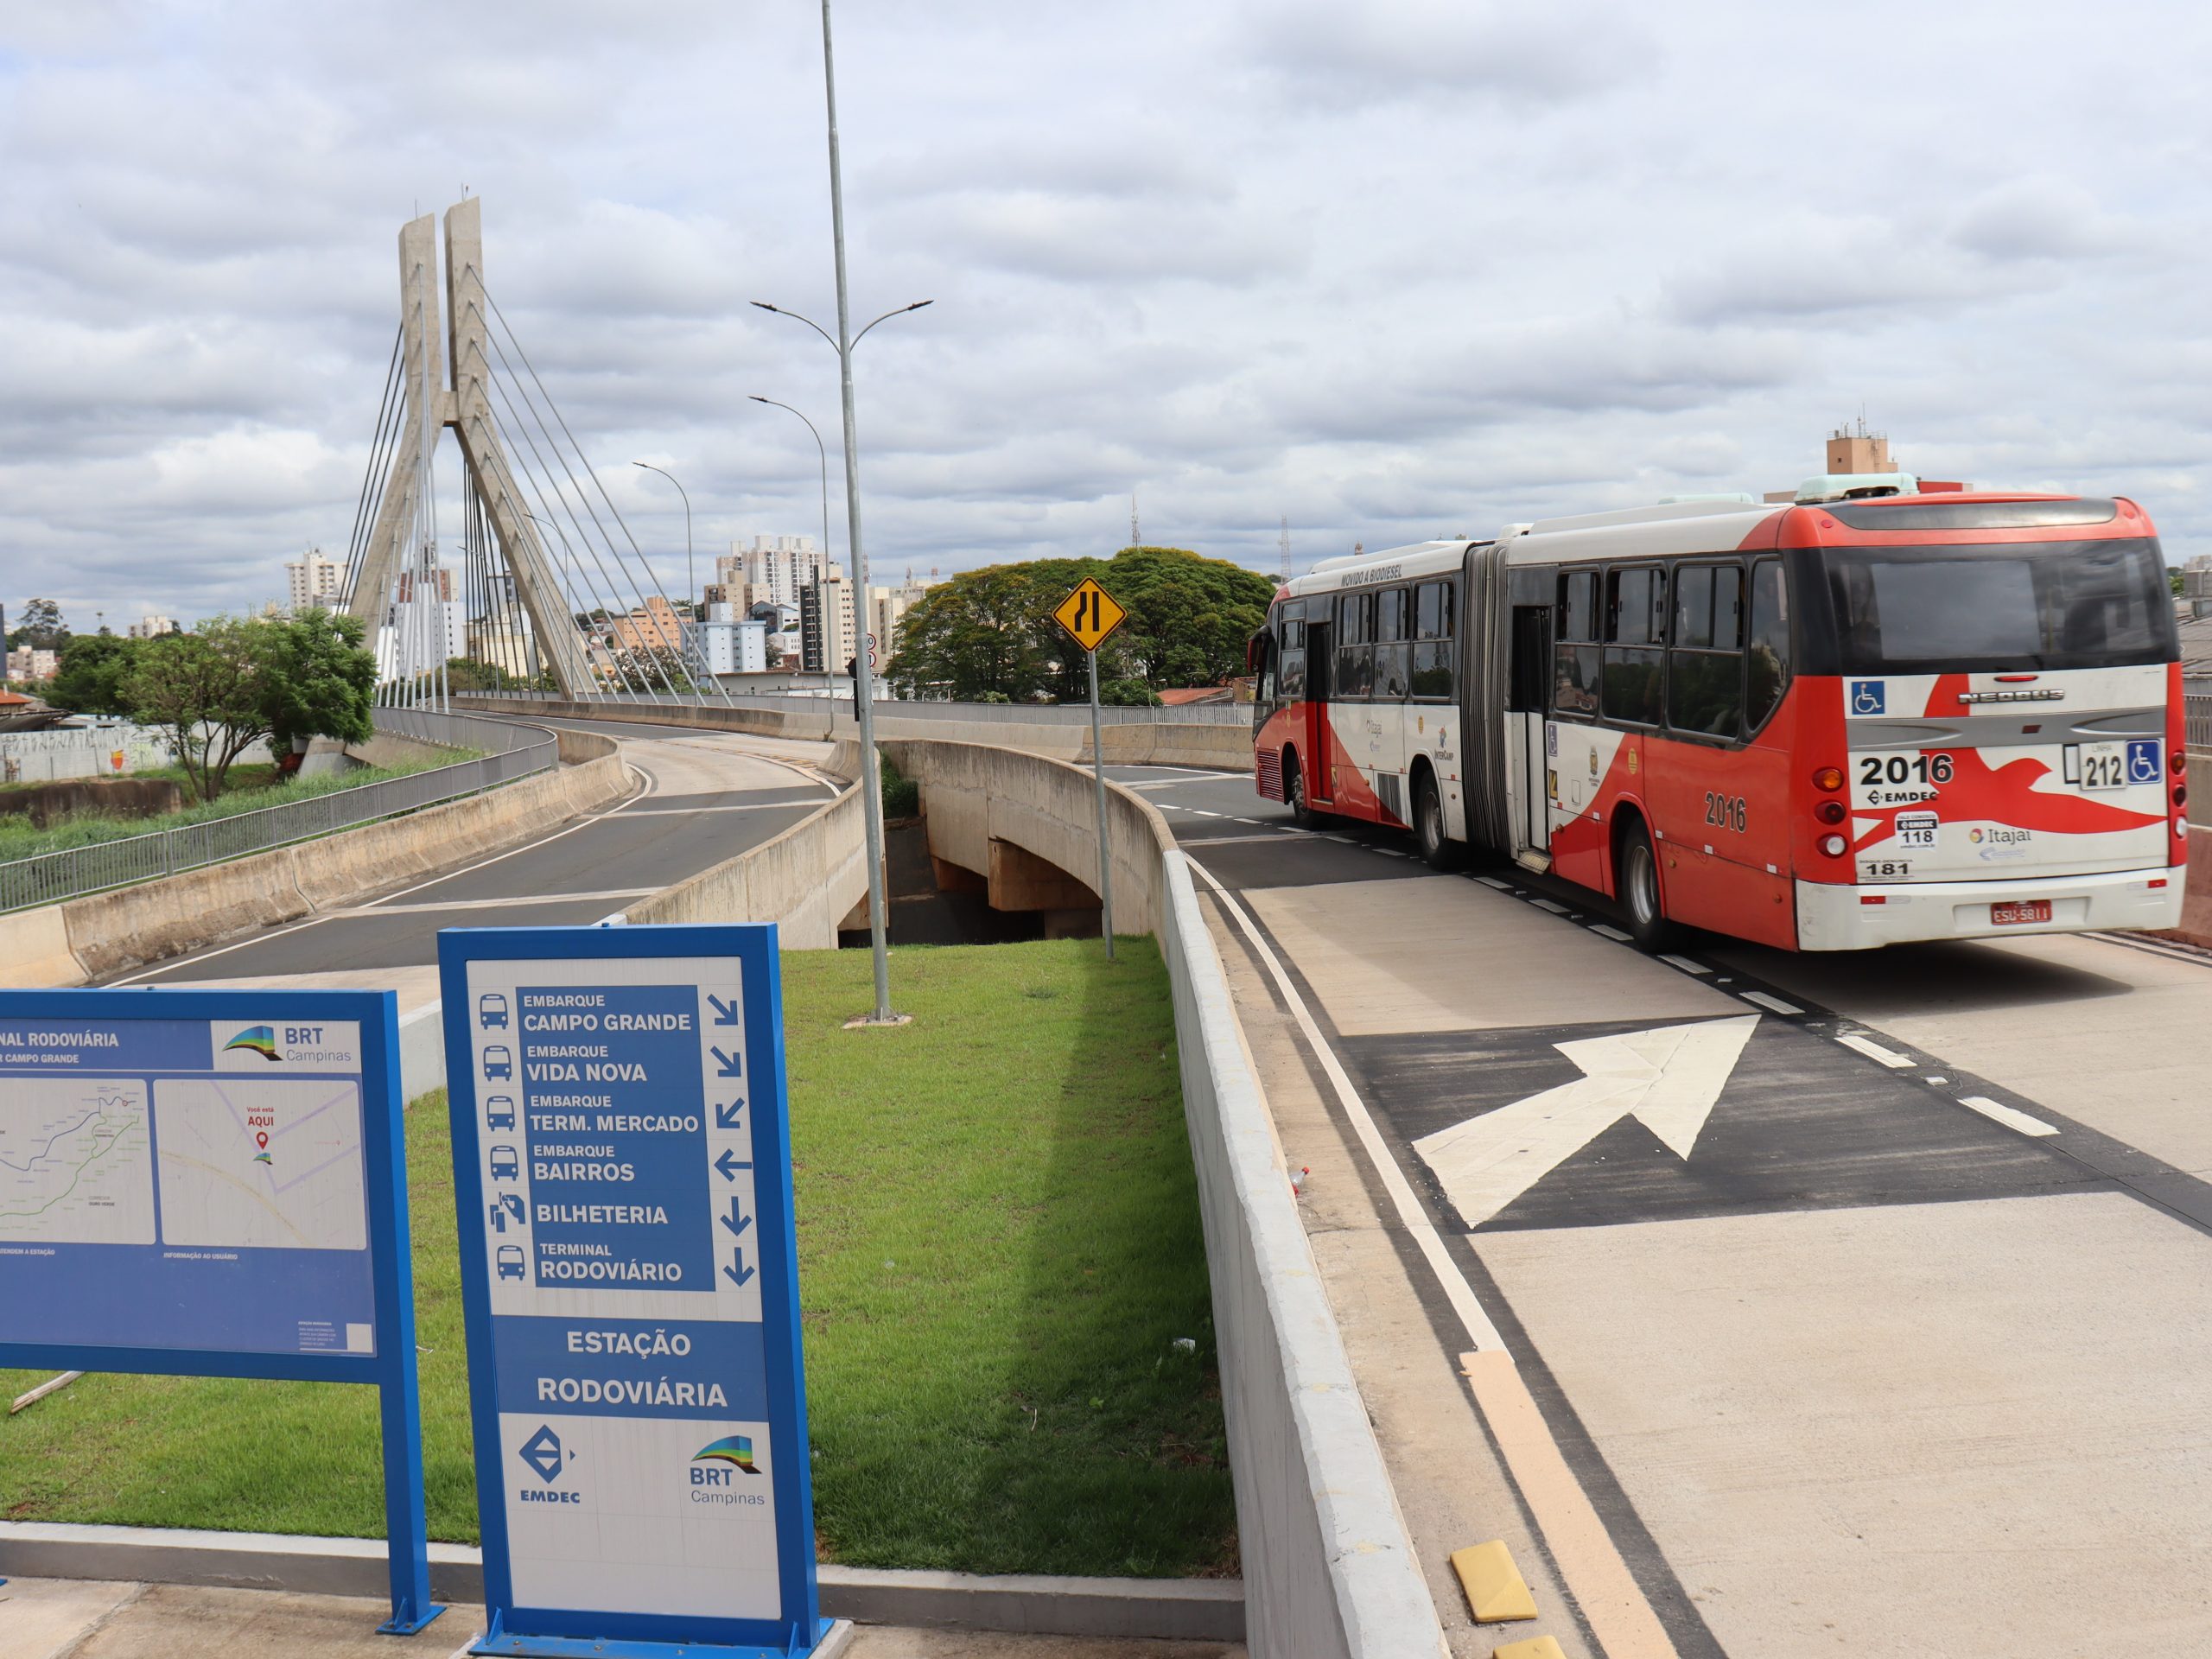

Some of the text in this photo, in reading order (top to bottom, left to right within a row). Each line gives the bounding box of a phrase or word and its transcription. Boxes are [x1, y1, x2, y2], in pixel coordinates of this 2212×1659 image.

[1341, 564, 1402, 587] MOVIDO A BIODIESEL
[1958, 690, 2065, 704] NEOBUS
[2092, 744, 2113, 753] LINHA
[1860, 753, 1954, 785] 2016
[2087, 756, 2122, 786] 212
[1885, 791, 1938, 802] EMDEC
[1705, 791, 1746, 833] 2016
[1902, 830, 1933, 843] 118
[1866, 863, 1908, 875] 181
[524, 995, 605, 1007] EMBARQUE
[524, 1014, 691, 1032] CAMPO GRANDE
[29, 1029, 119, 1047] RODOVIÁRIA
[285, 1027, 323, 1045] BRT
[5, 1053, 39, 1063] CAMPO
[41, 1054, 79, 1064] GRANDE
[286, 1049, 352, 1063] Campinas
[527, 1046, 608, 1058] EMBARQUE
[527, 1064, 647, 1082] VIDA NOVA
[531, 1096, 612, 1108] EMBARQUE
[248, 1116, 274, 1128] AQUI
[530, 1115, 699, 1133] TERM. MERCADO
[534, 1145, 615, 1158] EMBARQUE
[534, 1163, 635, 1181] BAIRROS
[537, 1205, 668, 1224] BILHETERIA
[29, 1248, 55, 1256] ESTAÇÃO
[163, 1251, 202, 1260] INFORMAÇÃO
[212, 1252, 238, 1261] USUÁRIO
[540, 1243, 612, 1256] TERMINAL
[540, 1258, 682, 1282] RODOVIÁRIO
[567, 1329, 691, 1358] ESTAÇÃO
[537, 1376, 728, 1408] RODOVIÁRIA
[690, 1467, 733, 1486] BRT
[520, 1490, 581, 1504] EMDEC
[691, 1491, 765, 1506] Campinas
